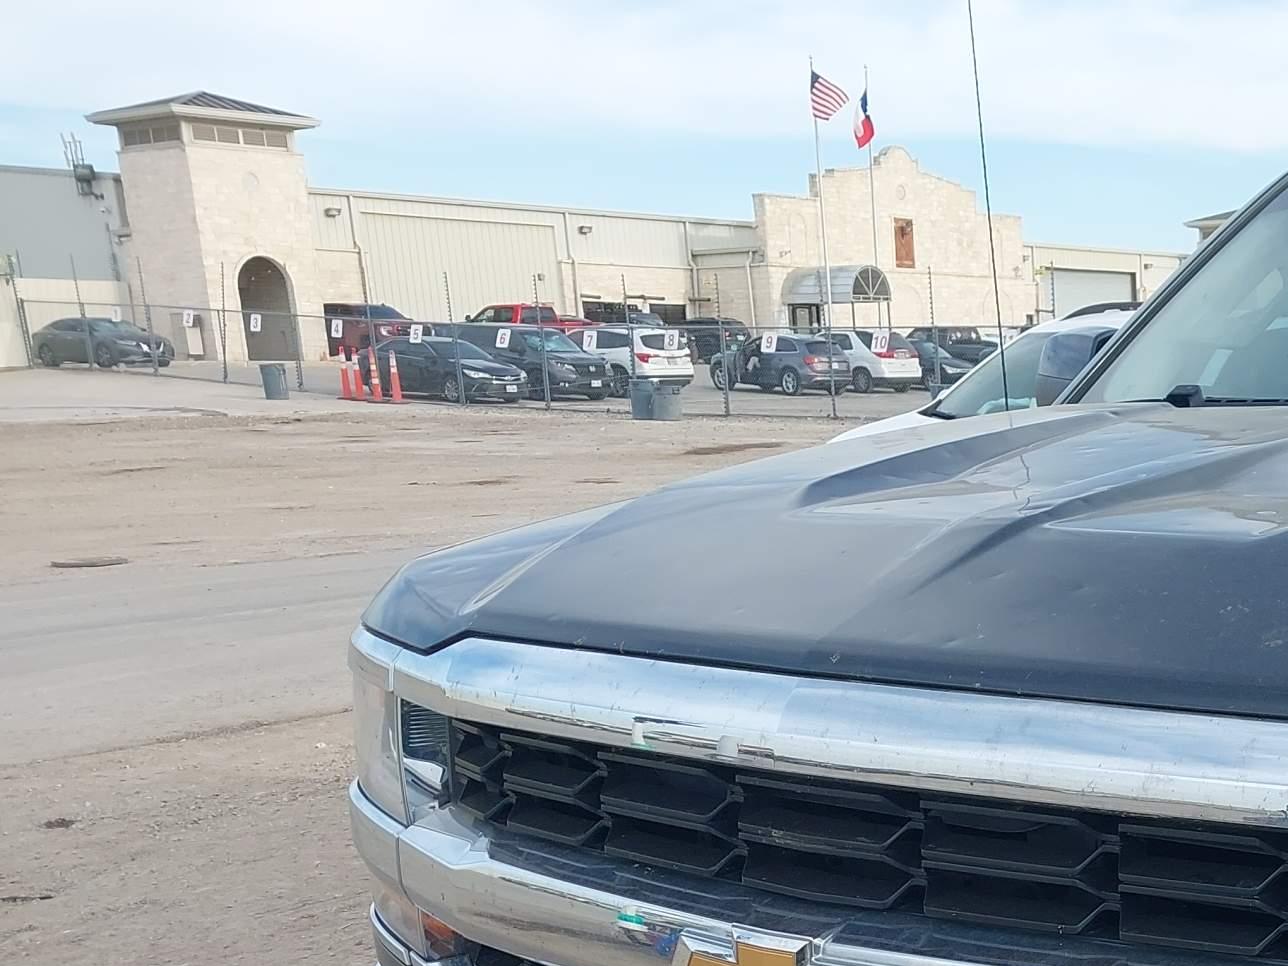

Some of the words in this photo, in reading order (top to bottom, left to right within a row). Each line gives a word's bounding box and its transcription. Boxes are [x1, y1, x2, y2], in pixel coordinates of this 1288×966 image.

[185, 312, 191, 324] 2
[252, 317, 259, 329] 3
[333, 322, 340, 334] 4
[412, 328, 420, 340] 5
[499, 332, 507, 344] 6
[586, 335, 594, 347] 7
[667, 334, 675, 347] 8
[765, 335, 774, 349] 9
[873, 335, 888, 350] 10
